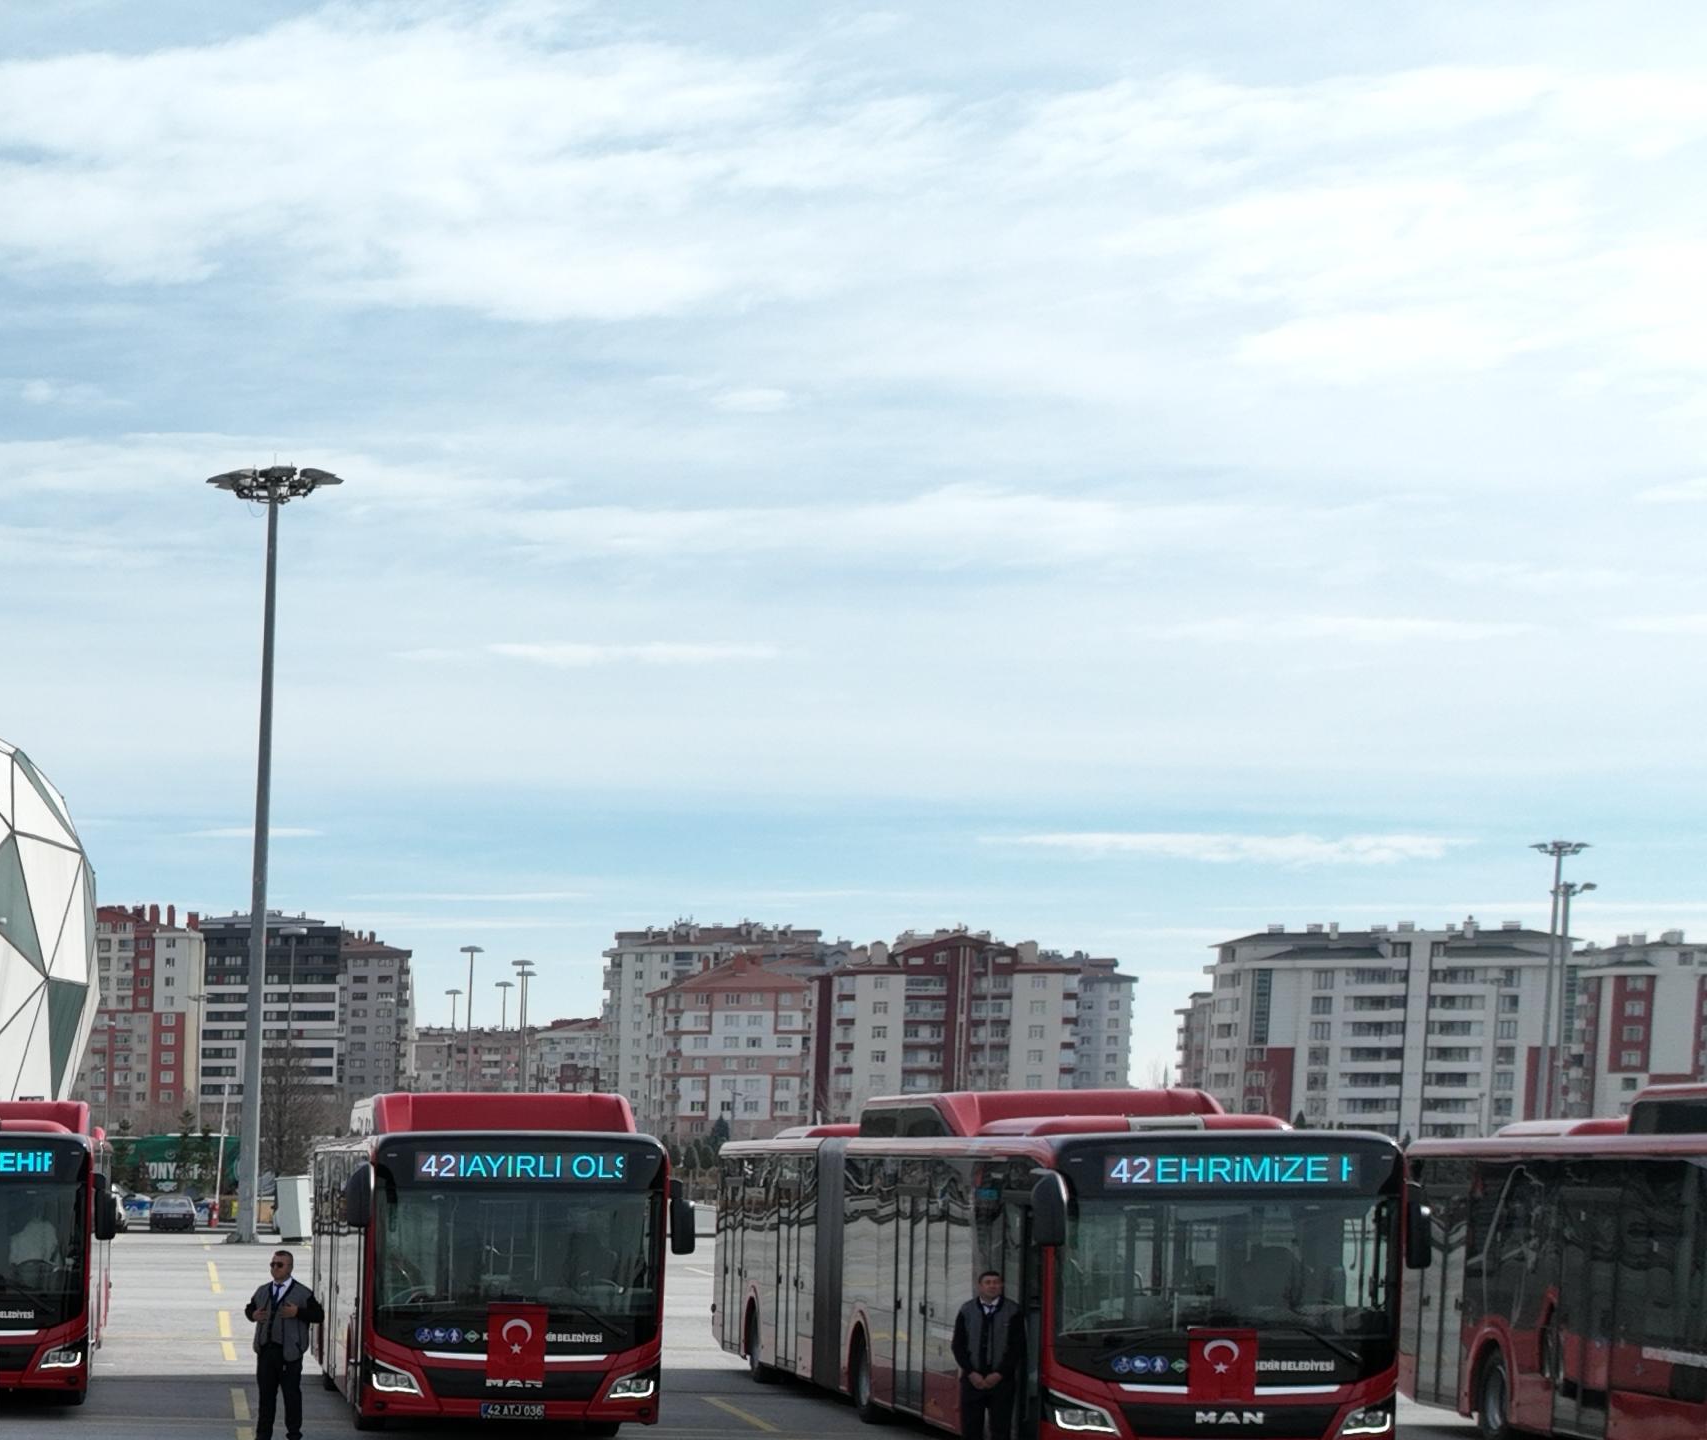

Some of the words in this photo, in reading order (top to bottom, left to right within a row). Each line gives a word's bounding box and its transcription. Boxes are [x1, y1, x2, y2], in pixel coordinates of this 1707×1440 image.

[420, 1154, 456, 1178] 42
[1110, 1157, 1152, 1184] 42
[487, 1404, 501, 1416] 42
[502, 1404, 522, 1416] ATJ
[1195, 1410, 1265, 1424] MAN
